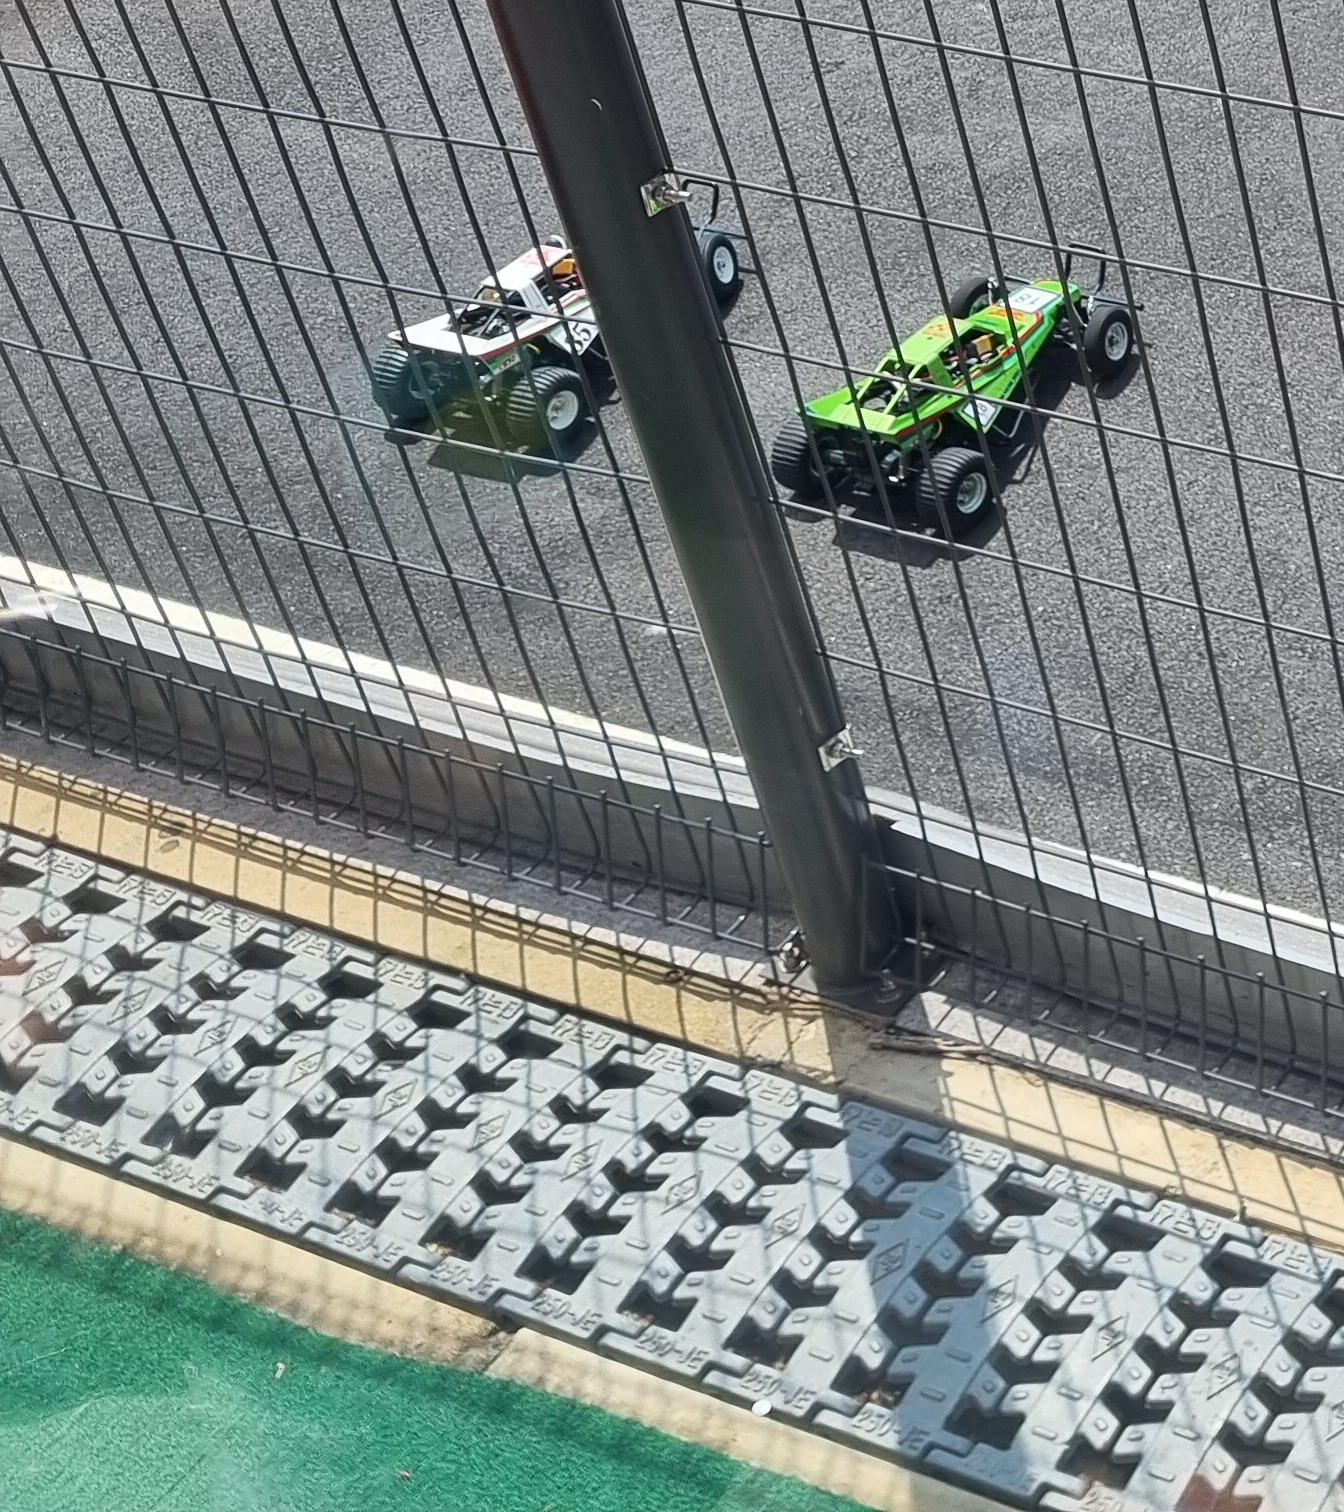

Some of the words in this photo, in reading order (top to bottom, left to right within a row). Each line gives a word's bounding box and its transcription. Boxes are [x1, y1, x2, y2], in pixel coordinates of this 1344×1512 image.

[532, 1292, 602, 1331] 250-JE
[635, 1332, 707, 1369] 250-JE
[741, 1368, 818, 1411] 250-JE
[852, 1406, 931, 1452] 250-JE
